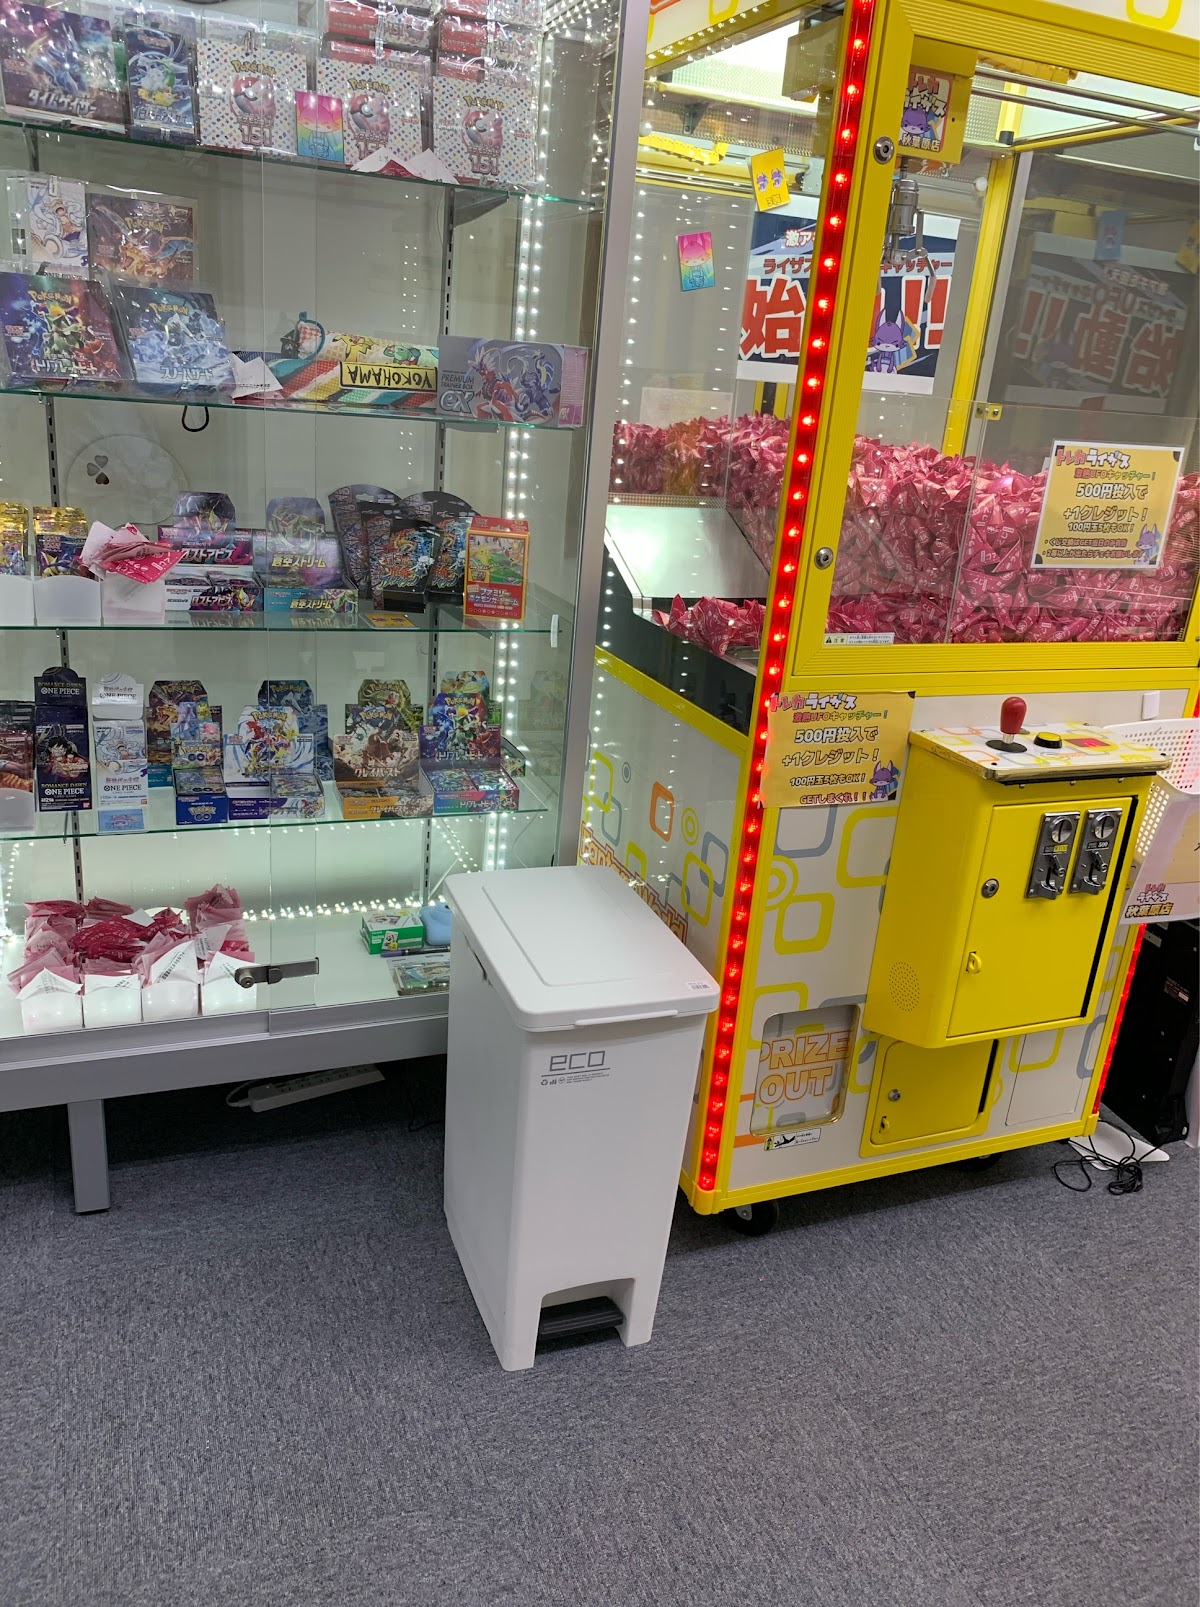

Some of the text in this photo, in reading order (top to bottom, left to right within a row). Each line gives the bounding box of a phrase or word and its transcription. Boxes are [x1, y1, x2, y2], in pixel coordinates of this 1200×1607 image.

[241, 124, 274, 147] 151
[901, 133, 941, 153] 秋葉原店
[469, 153, 500, 176] 151
[347, 364, 434, 390] YOKOHAMA
[441, 373, 475, 384] PREMIUM
[1075, 483, 1149, 500] 500円投入で
[794, 726, 879, 744] 500円投入で
[45, 787, 85, 796] ONE PIECE
[1125, 902, 1174, 918] 秋葉原店
[549, 1050, 606, 1072] eco
[759, 1066, 833, 1105] OUT
